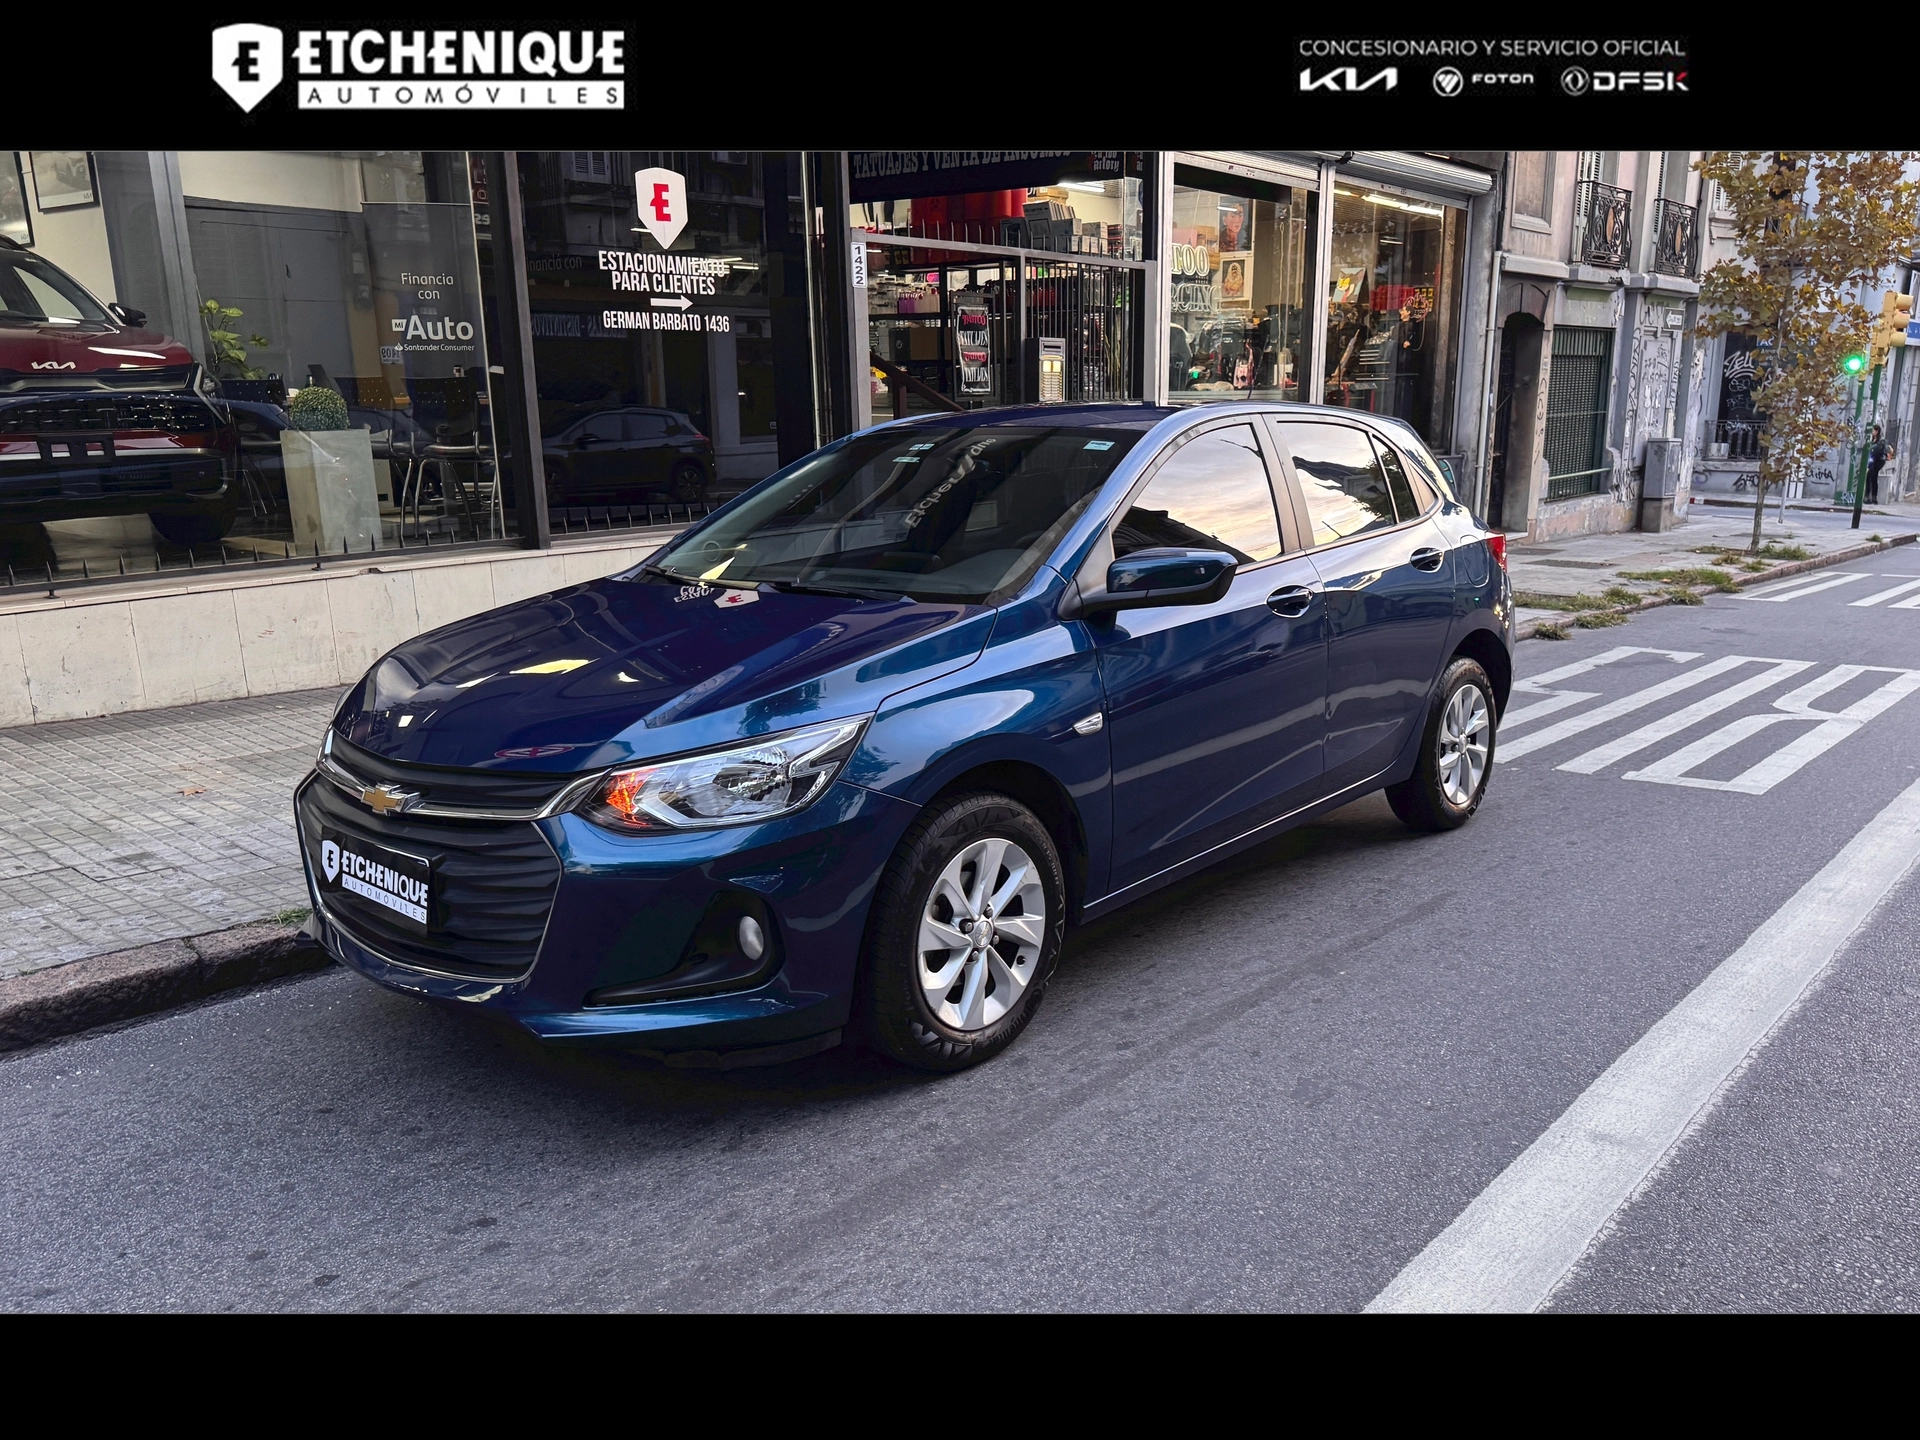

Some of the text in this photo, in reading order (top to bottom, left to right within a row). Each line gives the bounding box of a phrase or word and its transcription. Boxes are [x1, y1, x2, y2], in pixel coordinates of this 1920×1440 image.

[854, 151, 919, 178] TATUAJES
[921, 151, 930, 172] Y
[599, 250, 725, 278] ESTACIONAMIENTO
[854, 246, 864, 285] 1422
[401, 272, 454, 285] Financia
[612, 271, 715, 296] PARA CLIENTES
[418, 289, 440, 300] con
[406, 314, 474, 340] Auto
[603, 310, 730, 333] GERMAN BARBATO 1436
[403, 343, 440, 351] Santander
[341, 850, 429, 907] ETCHENIQUE
[344, 878, 426, 922] AUTOMÓVILES
